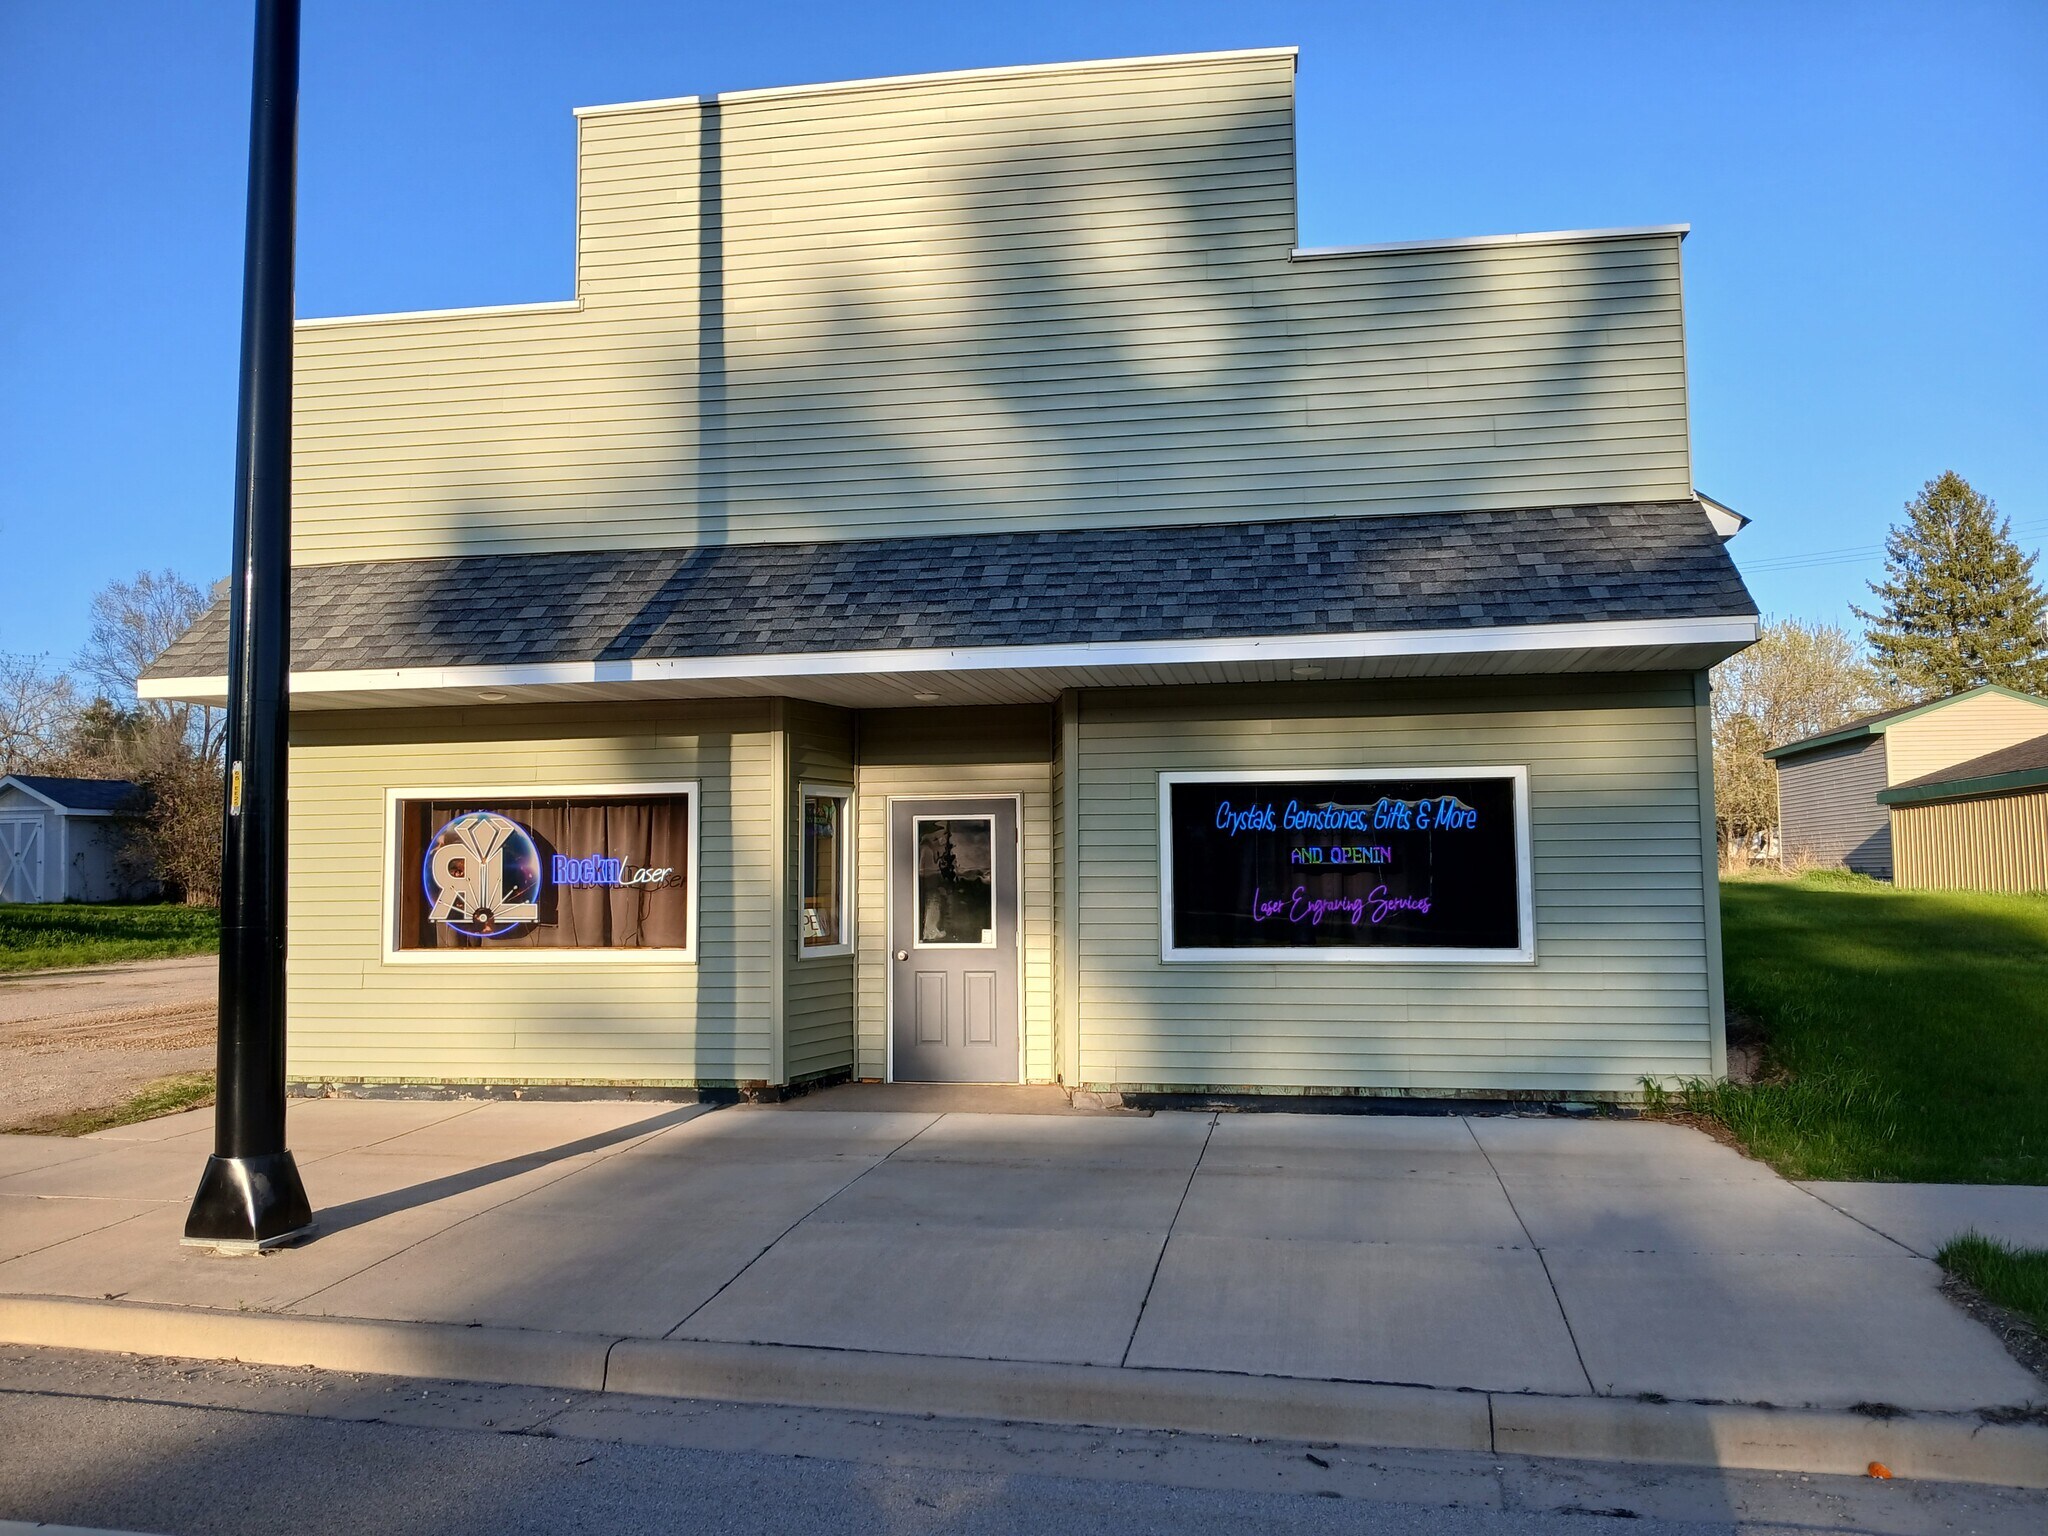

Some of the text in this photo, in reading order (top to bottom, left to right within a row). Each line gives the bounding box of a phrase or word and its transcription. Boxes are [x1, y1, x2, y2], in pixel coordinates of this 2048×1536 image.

[1216, 798, 1477, 837] Crystals, Gemstones, Gifts & More
[1291, 846, 1392, 864] AND OPENIN
[1253, 885, 1432, 925] Laser Engraving Services
